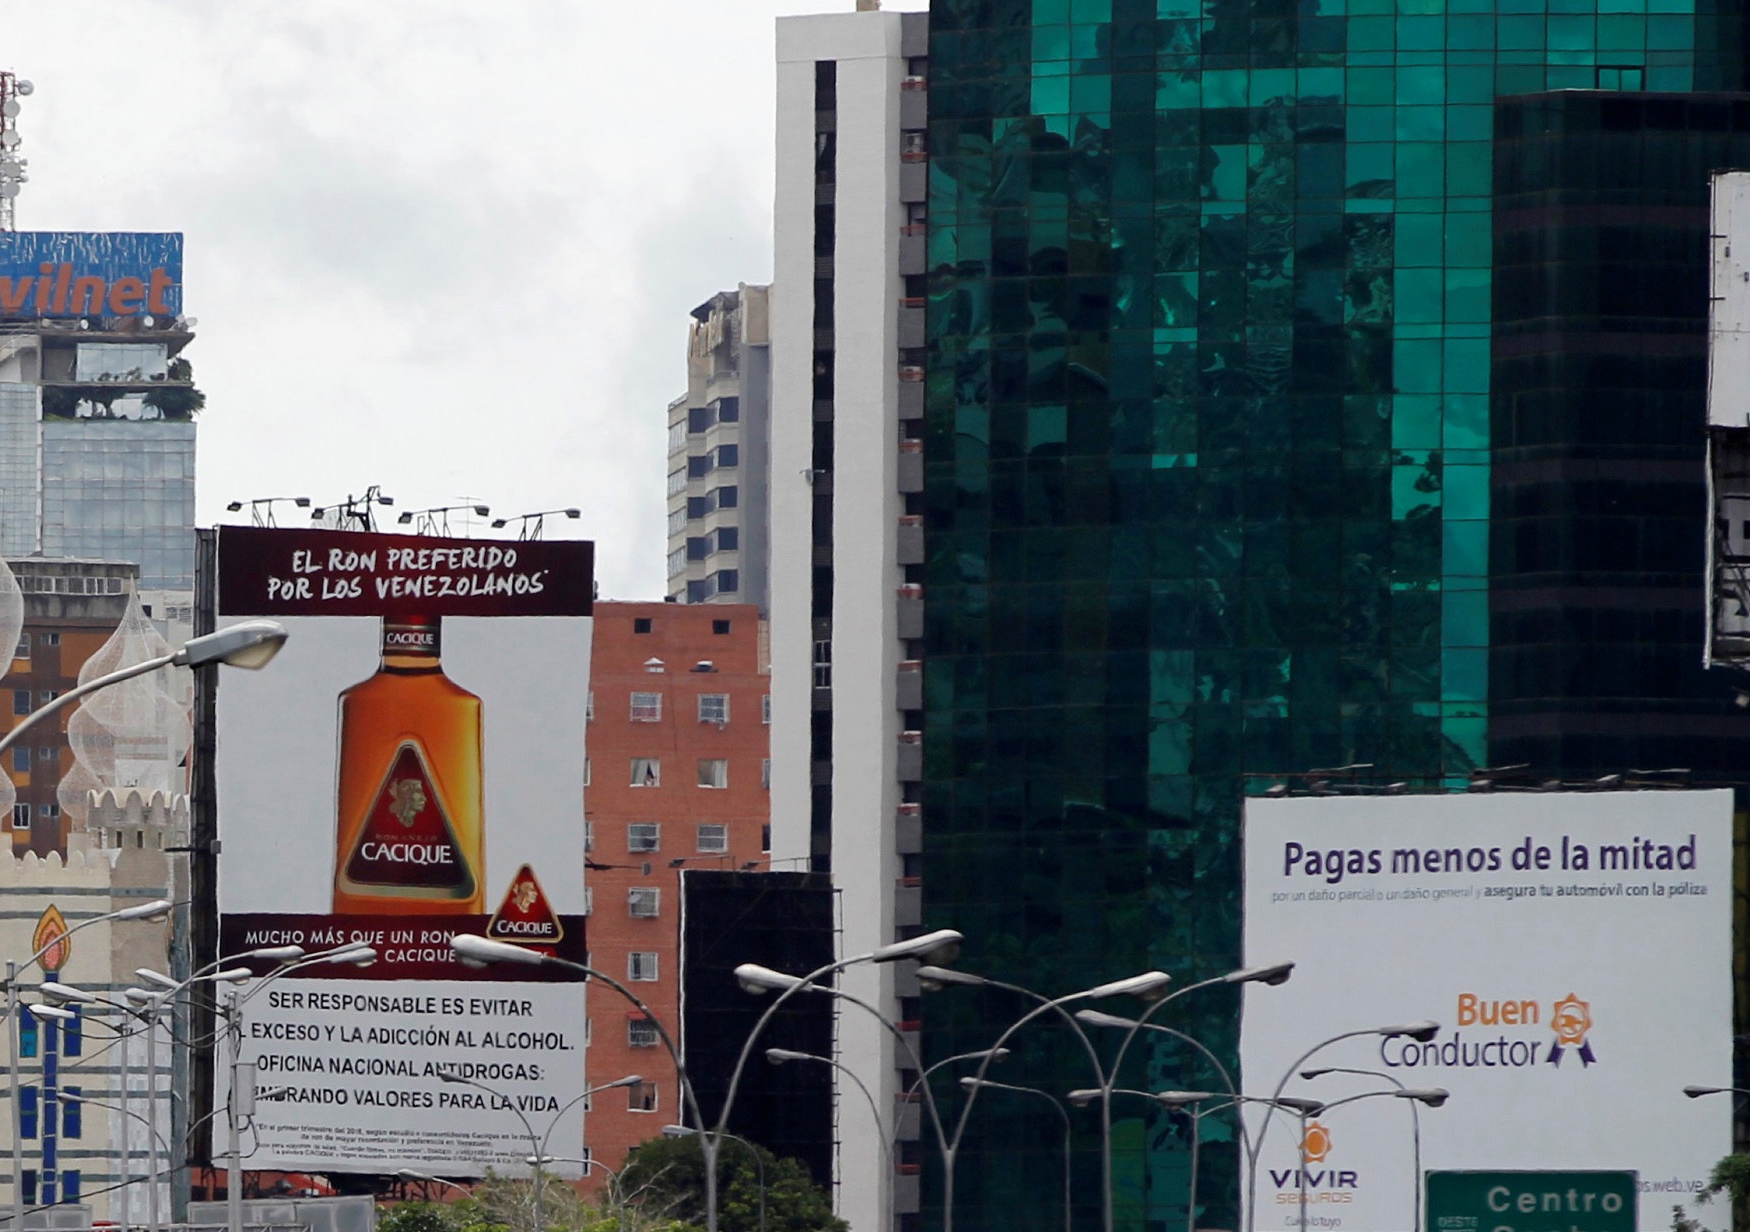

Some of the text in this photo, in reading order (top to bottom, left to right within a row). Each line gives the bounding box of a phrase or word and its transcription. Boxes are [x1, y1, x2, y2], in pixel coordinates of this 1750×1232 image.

[292, 547, 517, 574] EL RON PREFERIDO
[267, 577, 313, 600] POR
[321, 577, 361, 599] LOS
[386, 632, 434, 646] CACIQUE
[361, 842, 453, 866] CACIQUE
[1283, 835, 1696, 883] Pagas menos de la mitad
[1272, 891, 1290, 903] por
[1308, 889, 1335, 900] daño
[1484, 885, 1536, 900] asegura
[1540, 884, 1553, 896] tu
[1556, 883, 1623, 896] automóvil
[1626, 885, 1649, 896] con
[1652, 882, 1664, 896] la
[1668, 882, 1708, 899] póliza
[245, 926, 455, 945] MUCHO MÁS QUE UN RON
[497, 920, 552, 935] CACIQUE
[385, 949, 455, 962] CACIQUE
[269, 992, 533, 1017] SER RESPONSABLE ES EVITAR
[1457, 993, 1539, 1026] Buen
[251, 1023, 320, 1041] EXCESO
[324, 1025, 337, 1042] Y
[340, 1026, 363, 1043] LA
[367, 1025, 449, 1047] ADICCIÓN
[455, 1030, 477, 1048] AL
[482, 1031, 575, 1051] ALCOHOL.
[1380, 1033, 1541, 1068] Conductor
[257, 1055, 545, 1081] OFICINA NACIONAL ANTIDROGAS:
[353, 1089, 433, 1108] VALORES
[439, 1092, 485, 1110] PARA
[490, 1094, 512, 1111] LA
[516, 1095, 559, 1112] VIDA
[1268, 1169, 1358, 1188] VIVIR
[1488, 1185, 1623, 1212] Centro
